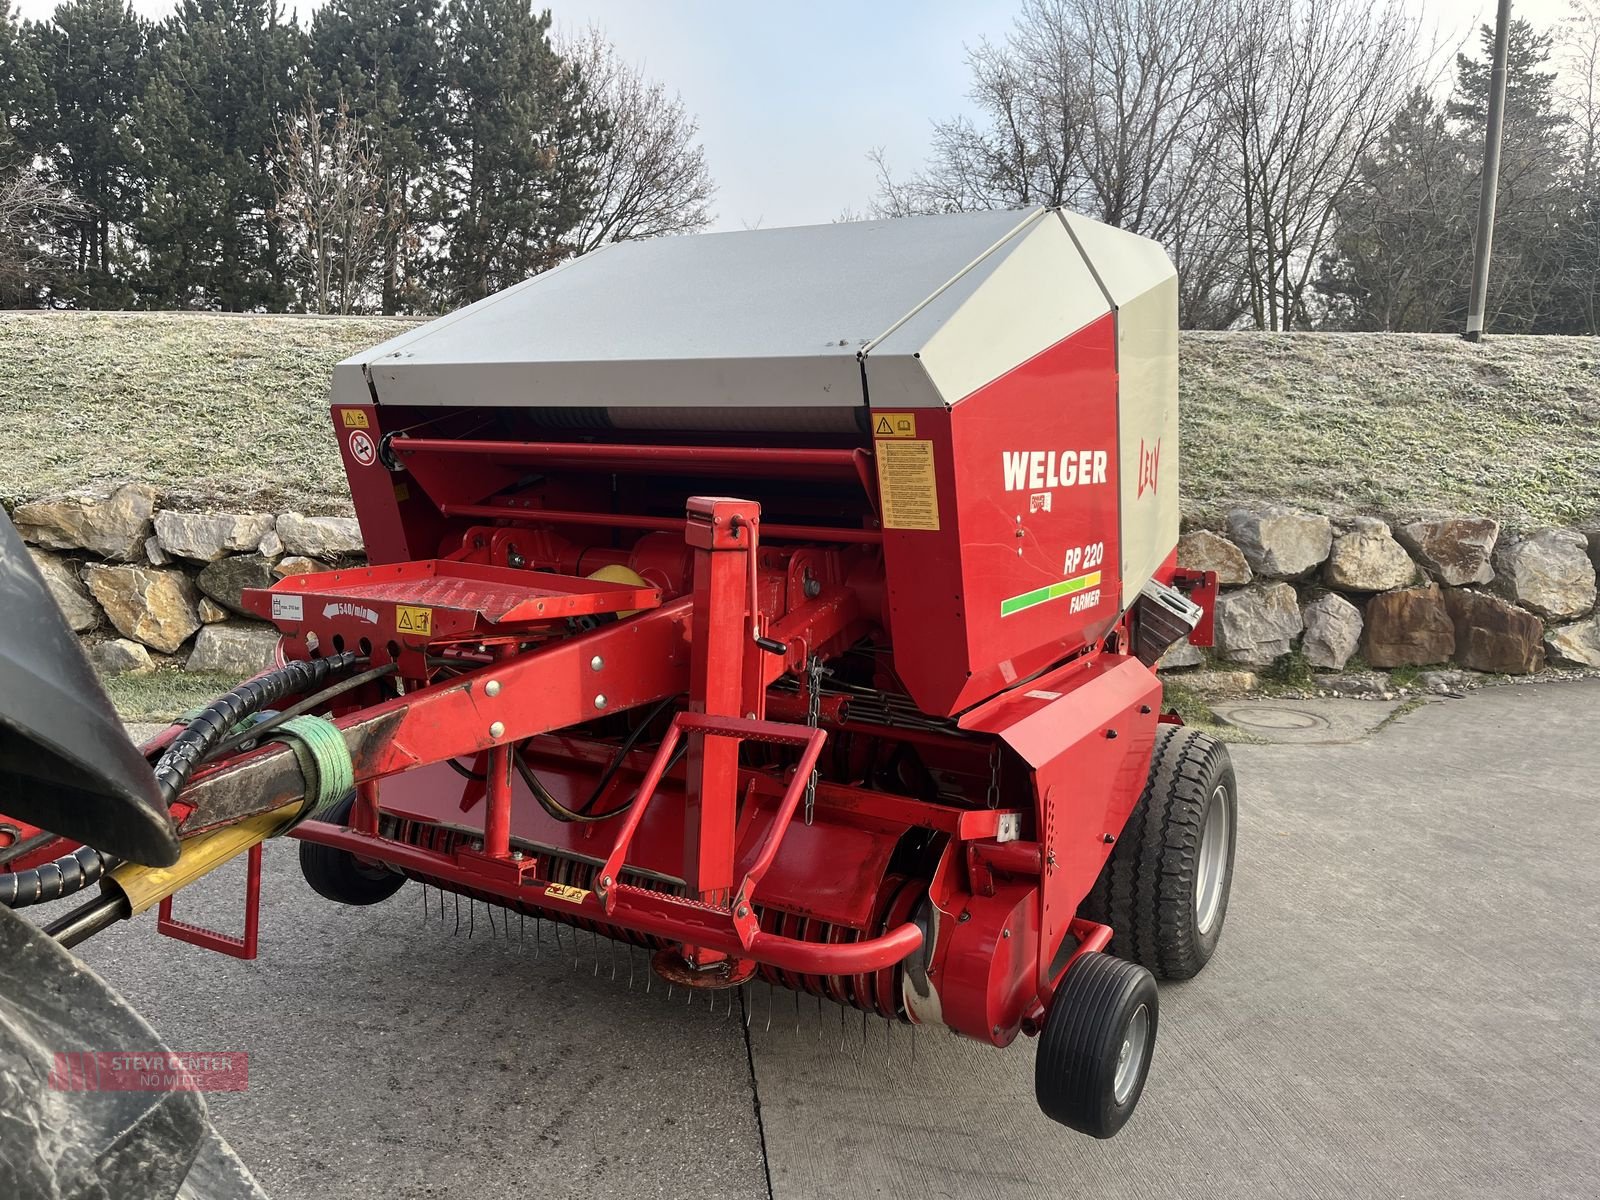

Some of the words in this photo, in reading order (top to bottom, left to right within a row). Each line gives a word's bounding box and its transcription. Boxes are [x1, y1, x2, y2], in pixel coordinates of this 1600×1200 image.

[1002, 450, 1107, 491] WELGER
[1138, 437, 1160, 500] LELY
[1064, 548, 1081, 575] RP
[1082, 542, 1103, 569] 220
[338, 603, 367, 618] 540/min
[1069, 589, 1100, 615] FARMER
